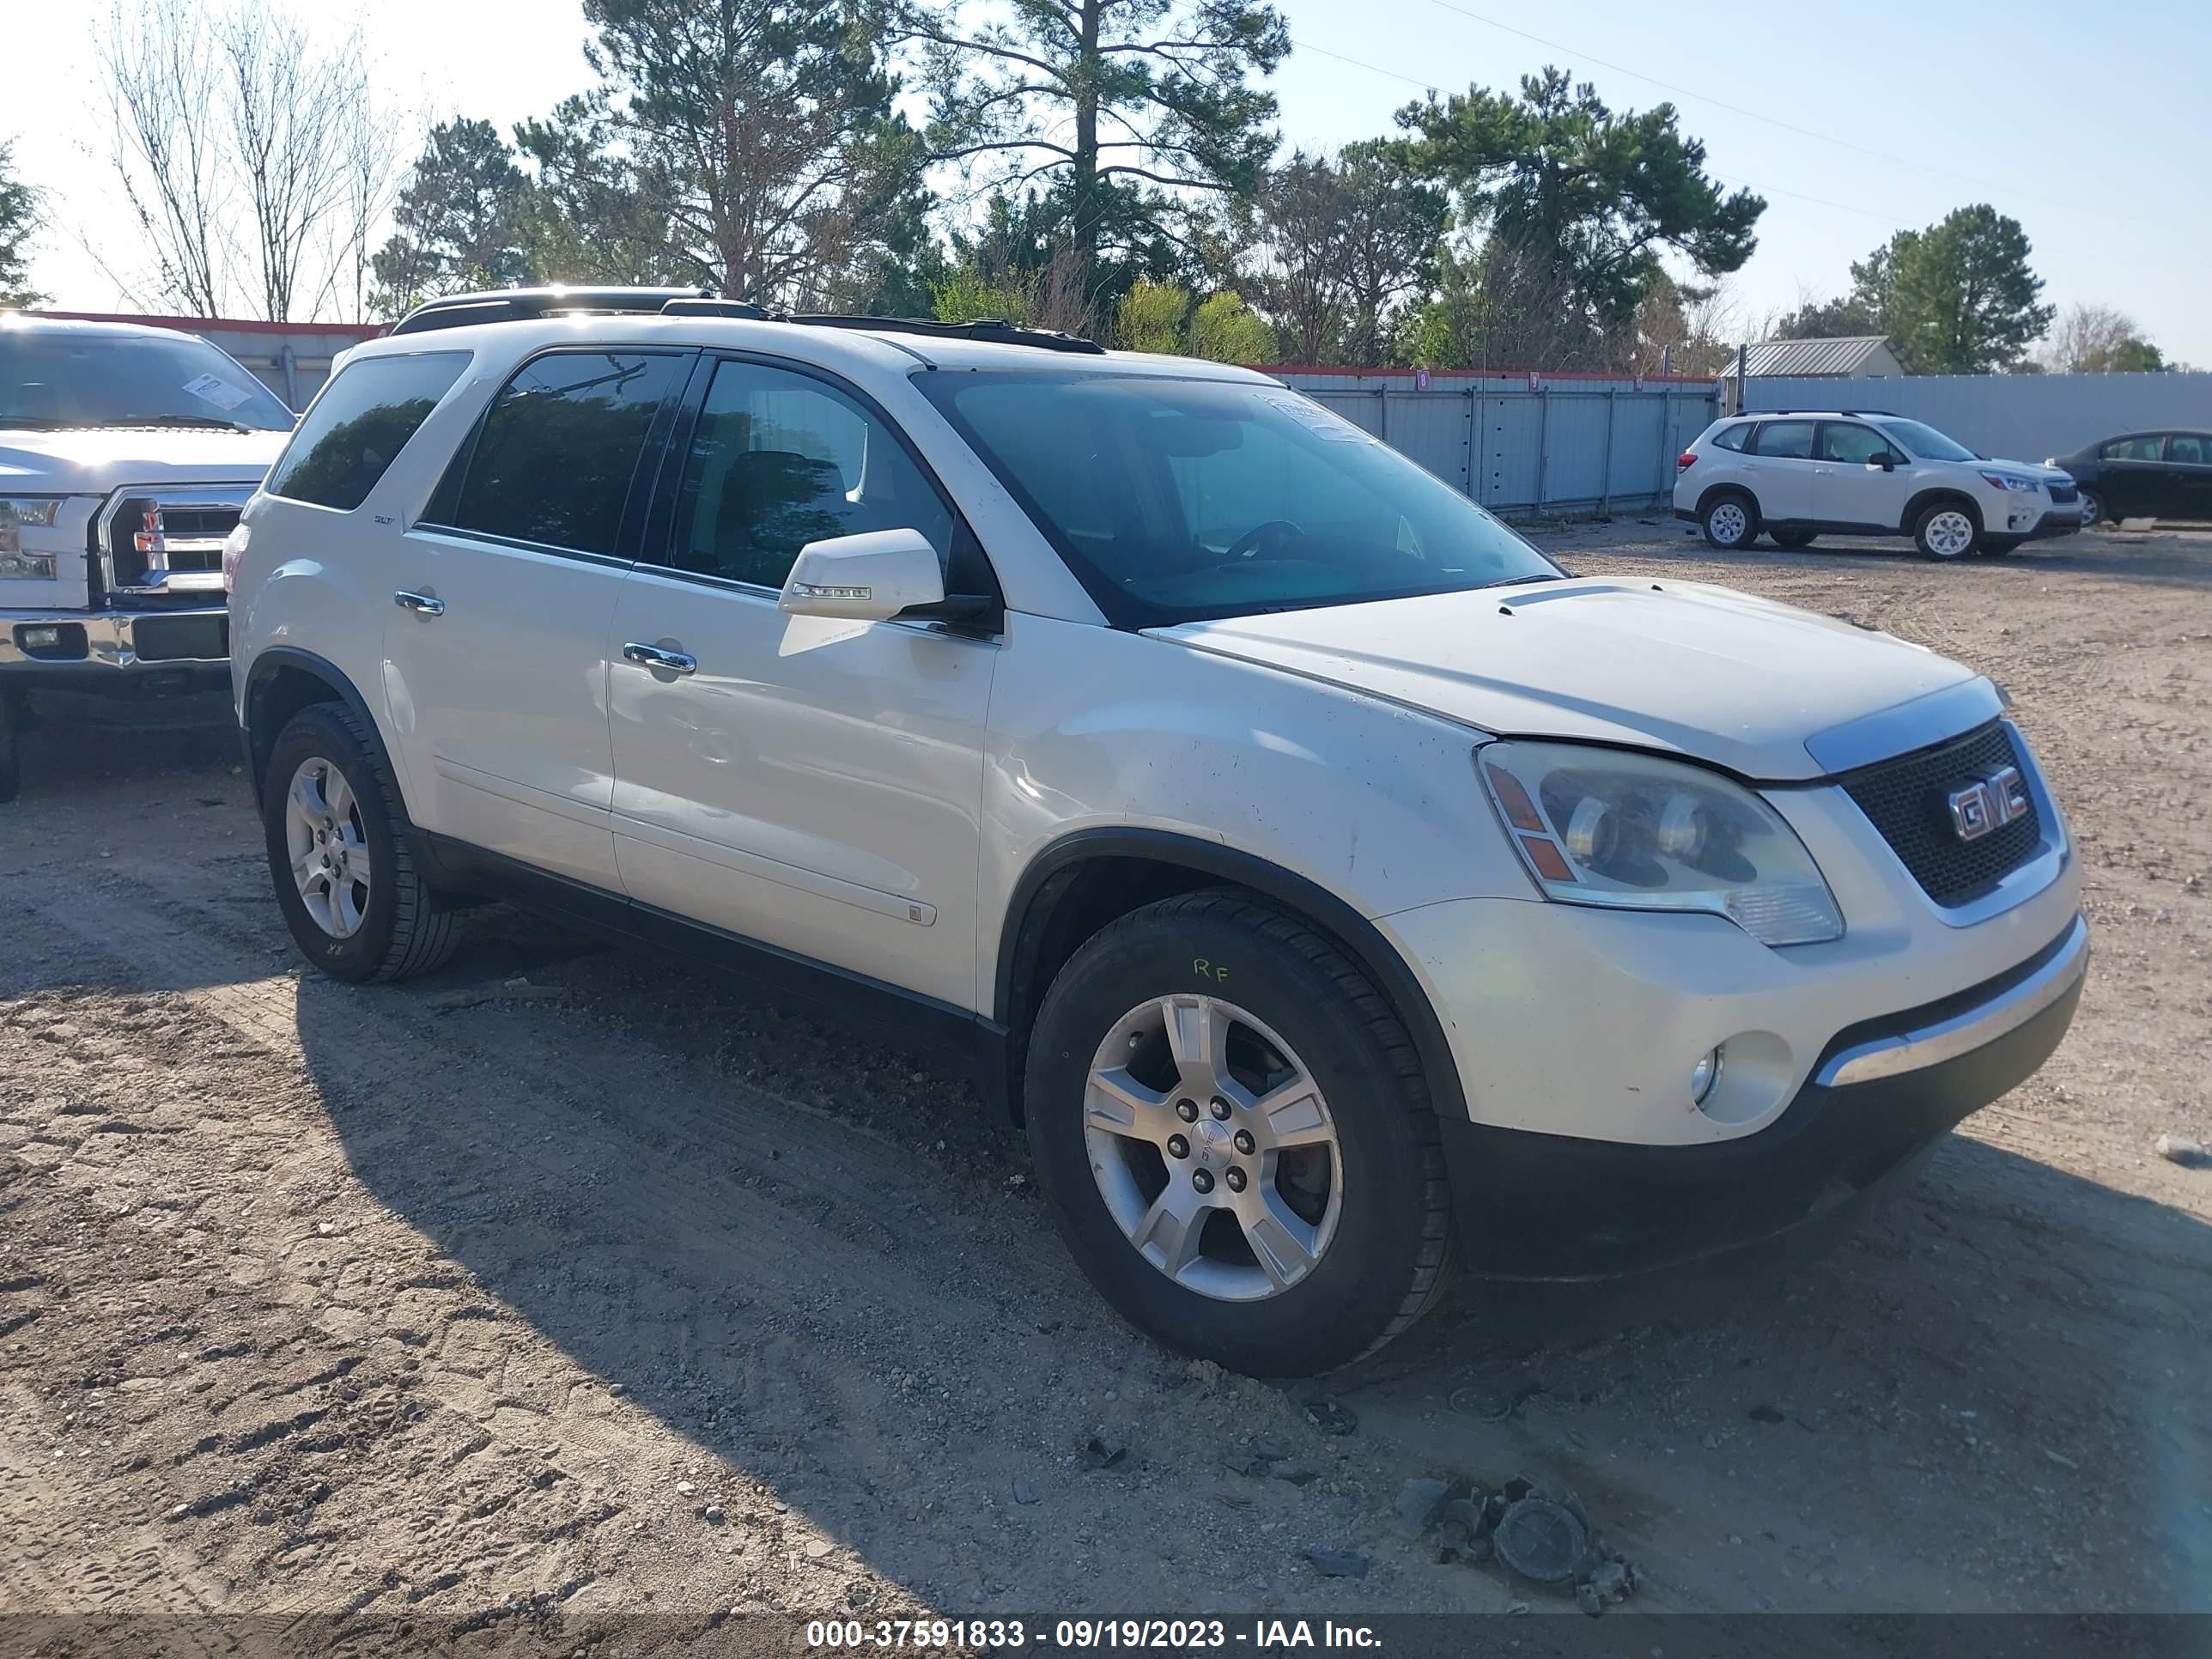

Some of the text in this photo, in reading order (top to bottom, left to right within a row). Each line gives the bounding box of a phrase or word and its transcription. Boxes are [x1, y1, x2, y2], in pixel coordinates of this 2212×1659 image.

[1948, 766, 2027, 841] GMC
[1194, 957, 1228, 982] RF
[1201, 1127, 1216, 1162] GMC
